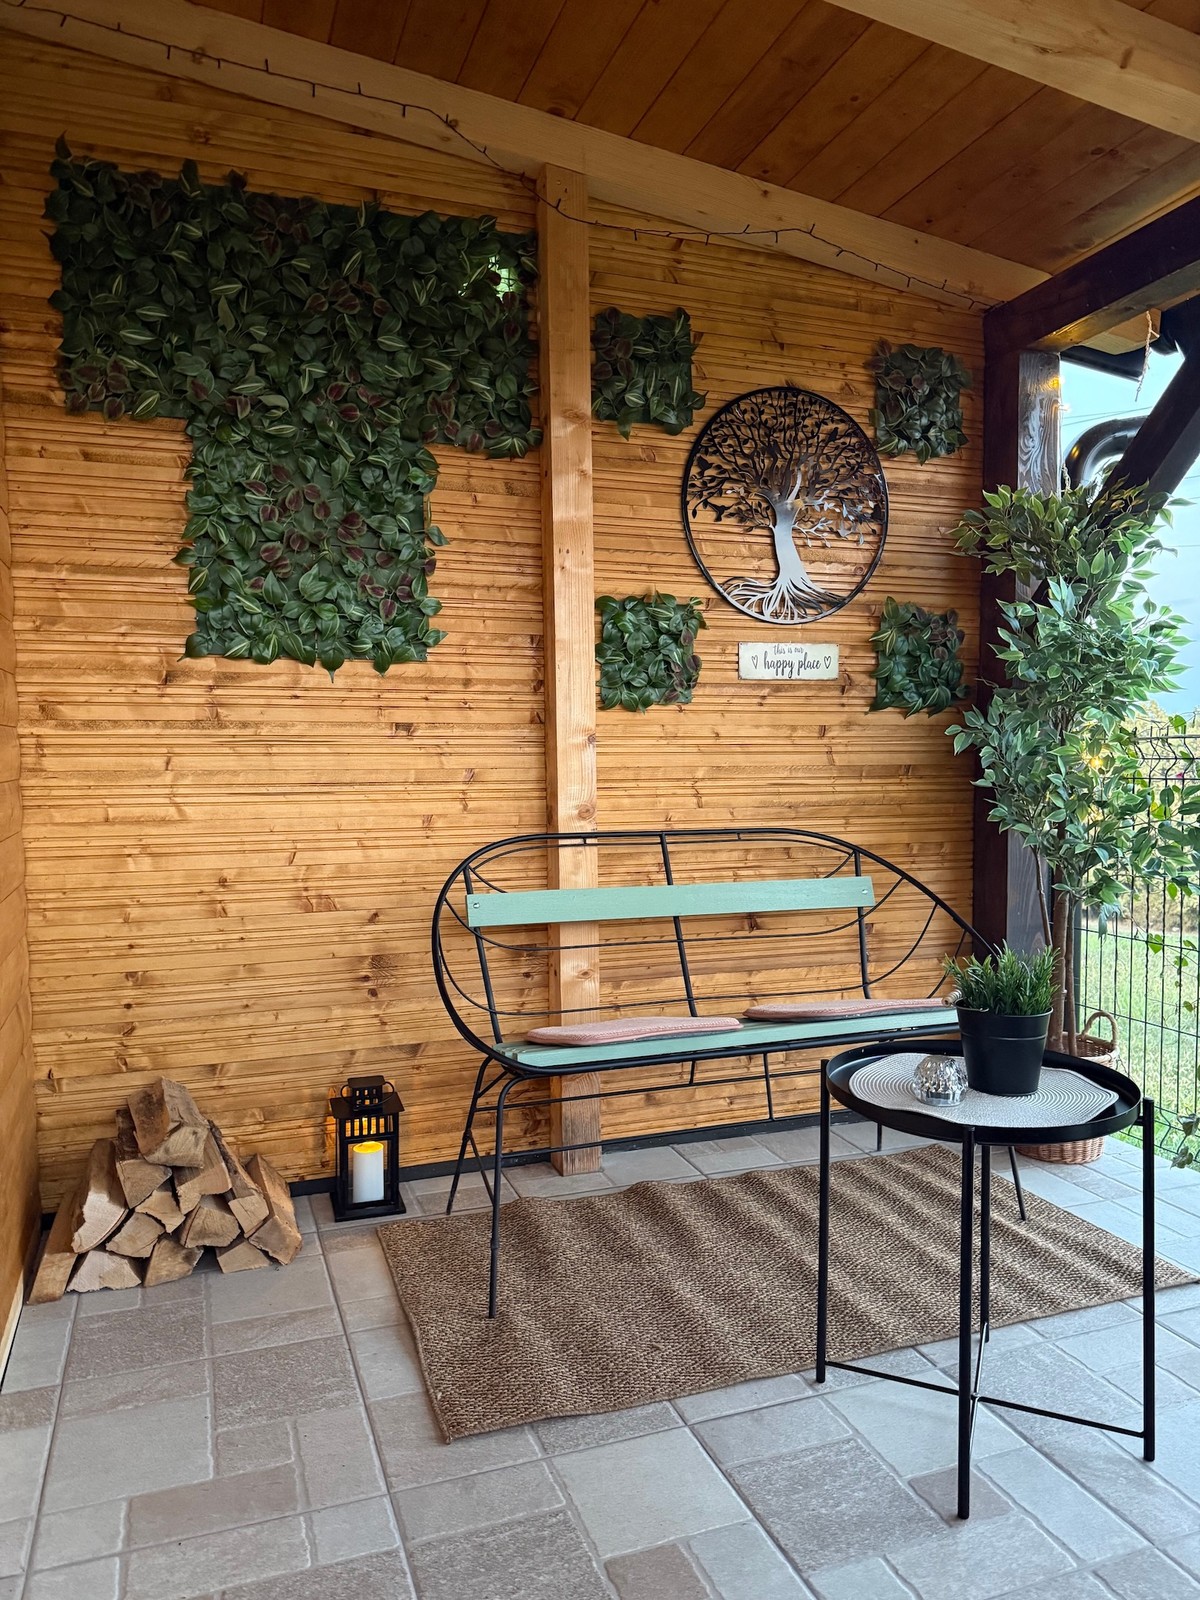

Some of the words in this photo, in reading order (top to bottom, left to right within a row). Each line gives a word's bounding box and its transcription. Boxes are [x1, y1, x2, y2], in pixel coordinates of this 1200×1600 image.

[773, 644, 786, 655] this
[787, 645, 793, 654] is
[794, 646, 804, 654] our
[763, 650, 795, 678] happy
[797, 651, 821, 676] place
